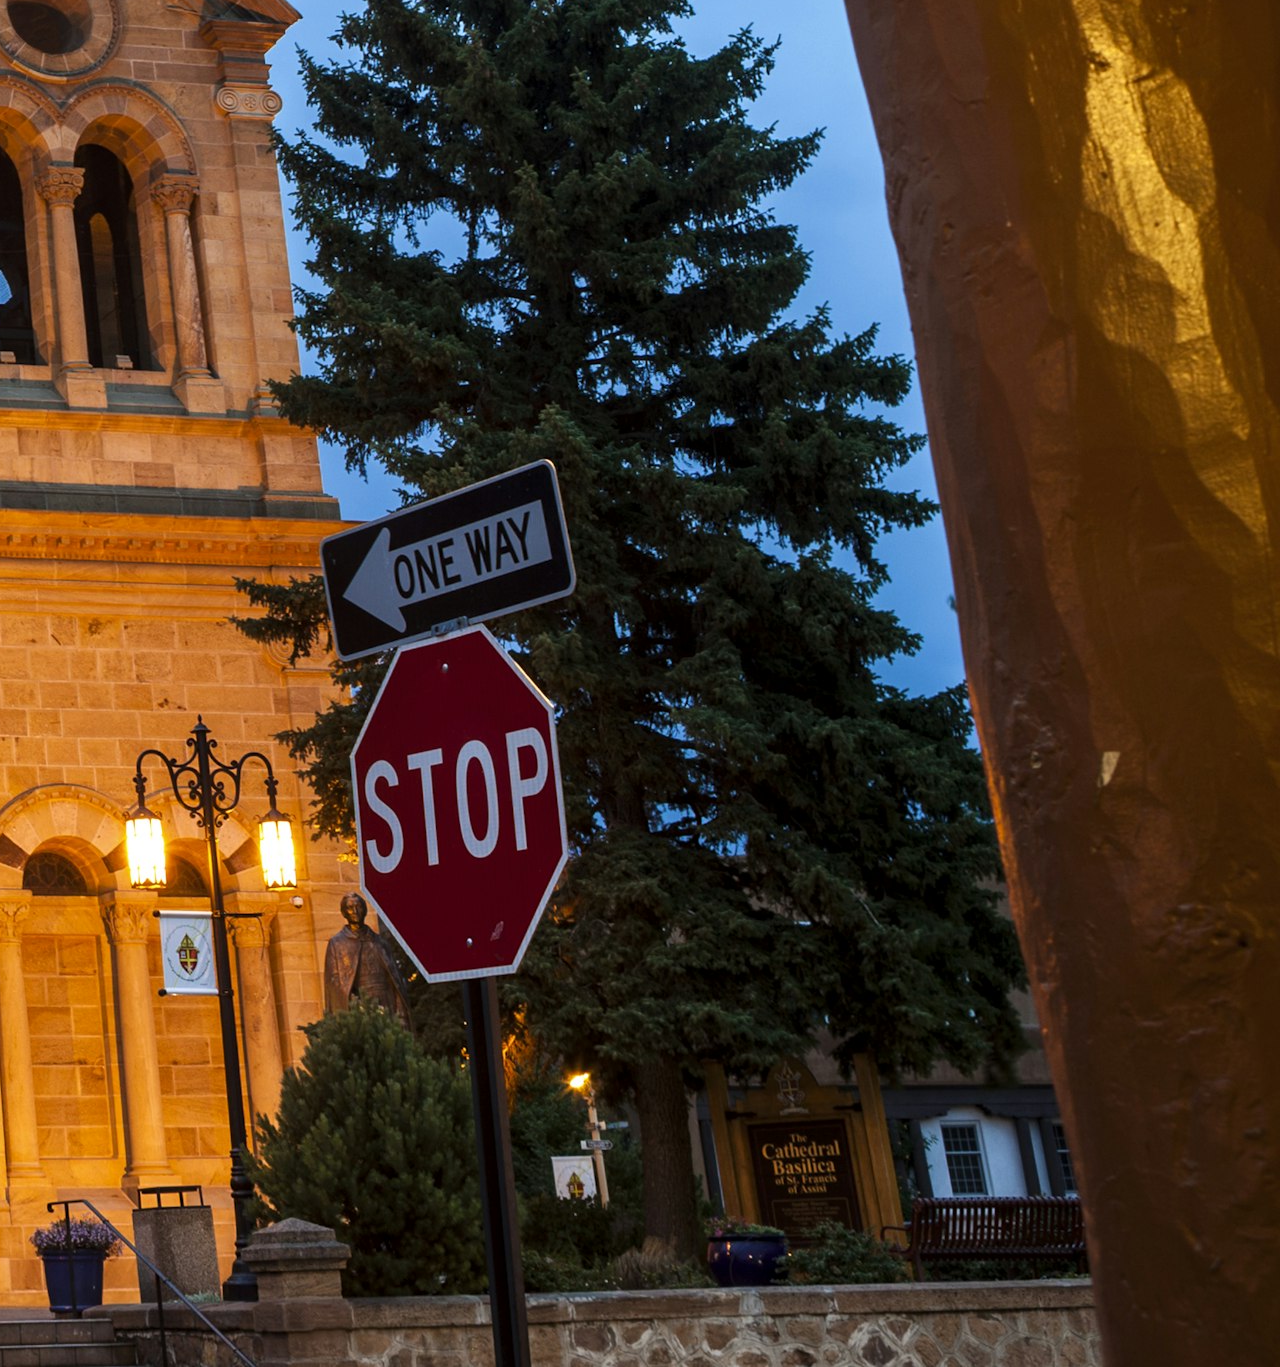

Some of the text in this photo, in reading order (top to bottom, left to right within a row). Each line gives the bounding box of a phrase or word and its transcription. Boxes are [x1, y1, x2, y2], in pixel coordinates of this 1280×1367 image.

[393, 511, 530, 599] ONE WAY
[365, 727, 549, 874] STOP
[790, 1133, 807, 1143] The
[761, 1140, 841, 1160] Cathedral
[773, 1158, 836, 1175] Basilica
[775, 1173, 837, 1185] of St. Francis
[787, 1183, 827, 1194] of Assisi
